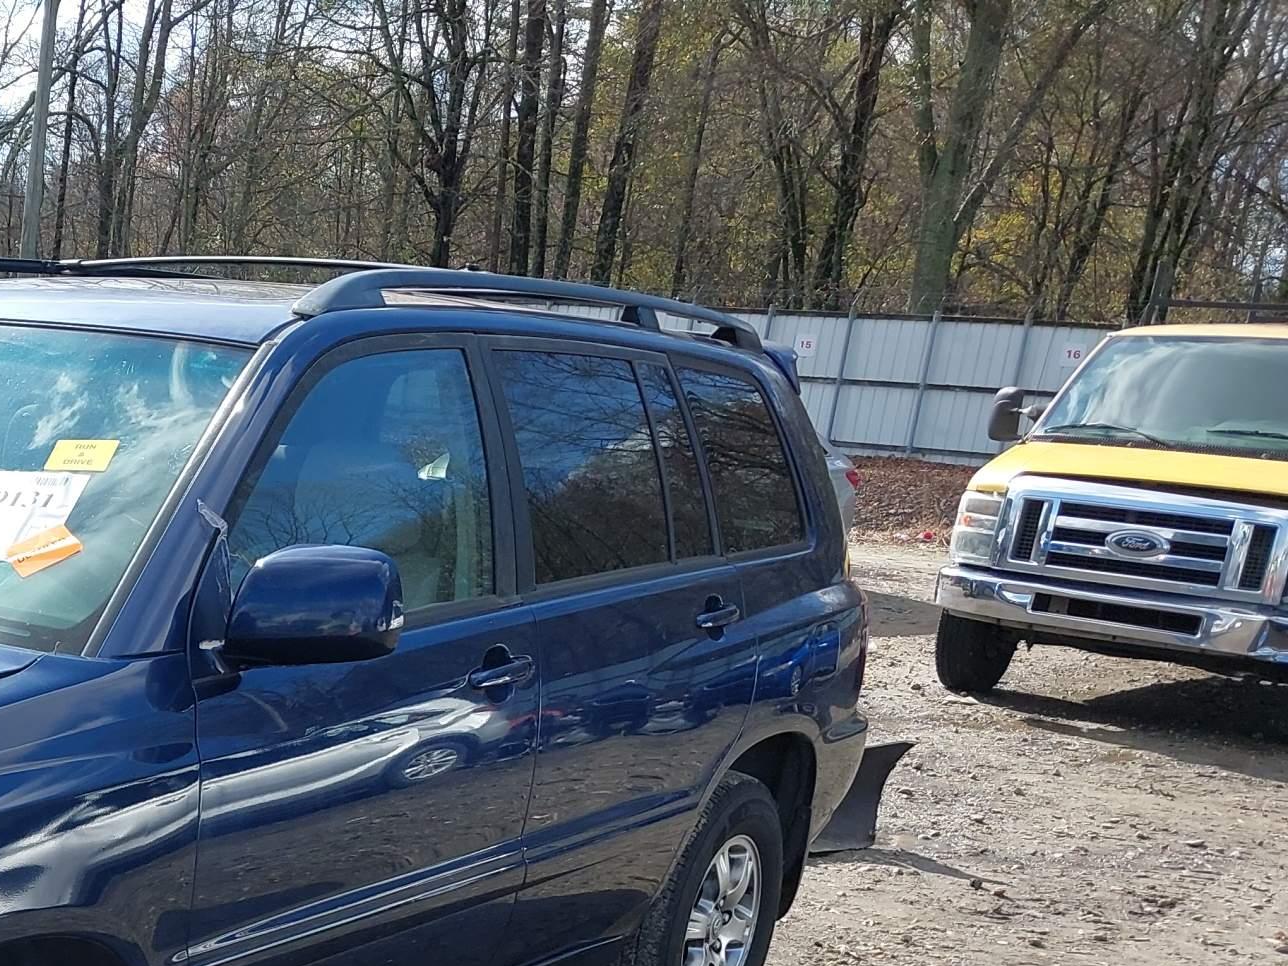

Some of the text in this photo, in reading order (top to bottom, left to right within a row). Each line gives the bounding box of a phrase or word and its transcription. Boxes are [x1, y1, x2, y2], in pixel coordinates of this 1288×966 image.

[800, 340, 812, 349] 15
[1066, 349, 1081, 360] 16
[74, 443, 97, 451] RUN
[62, 458, 94, 466] DRIVE
